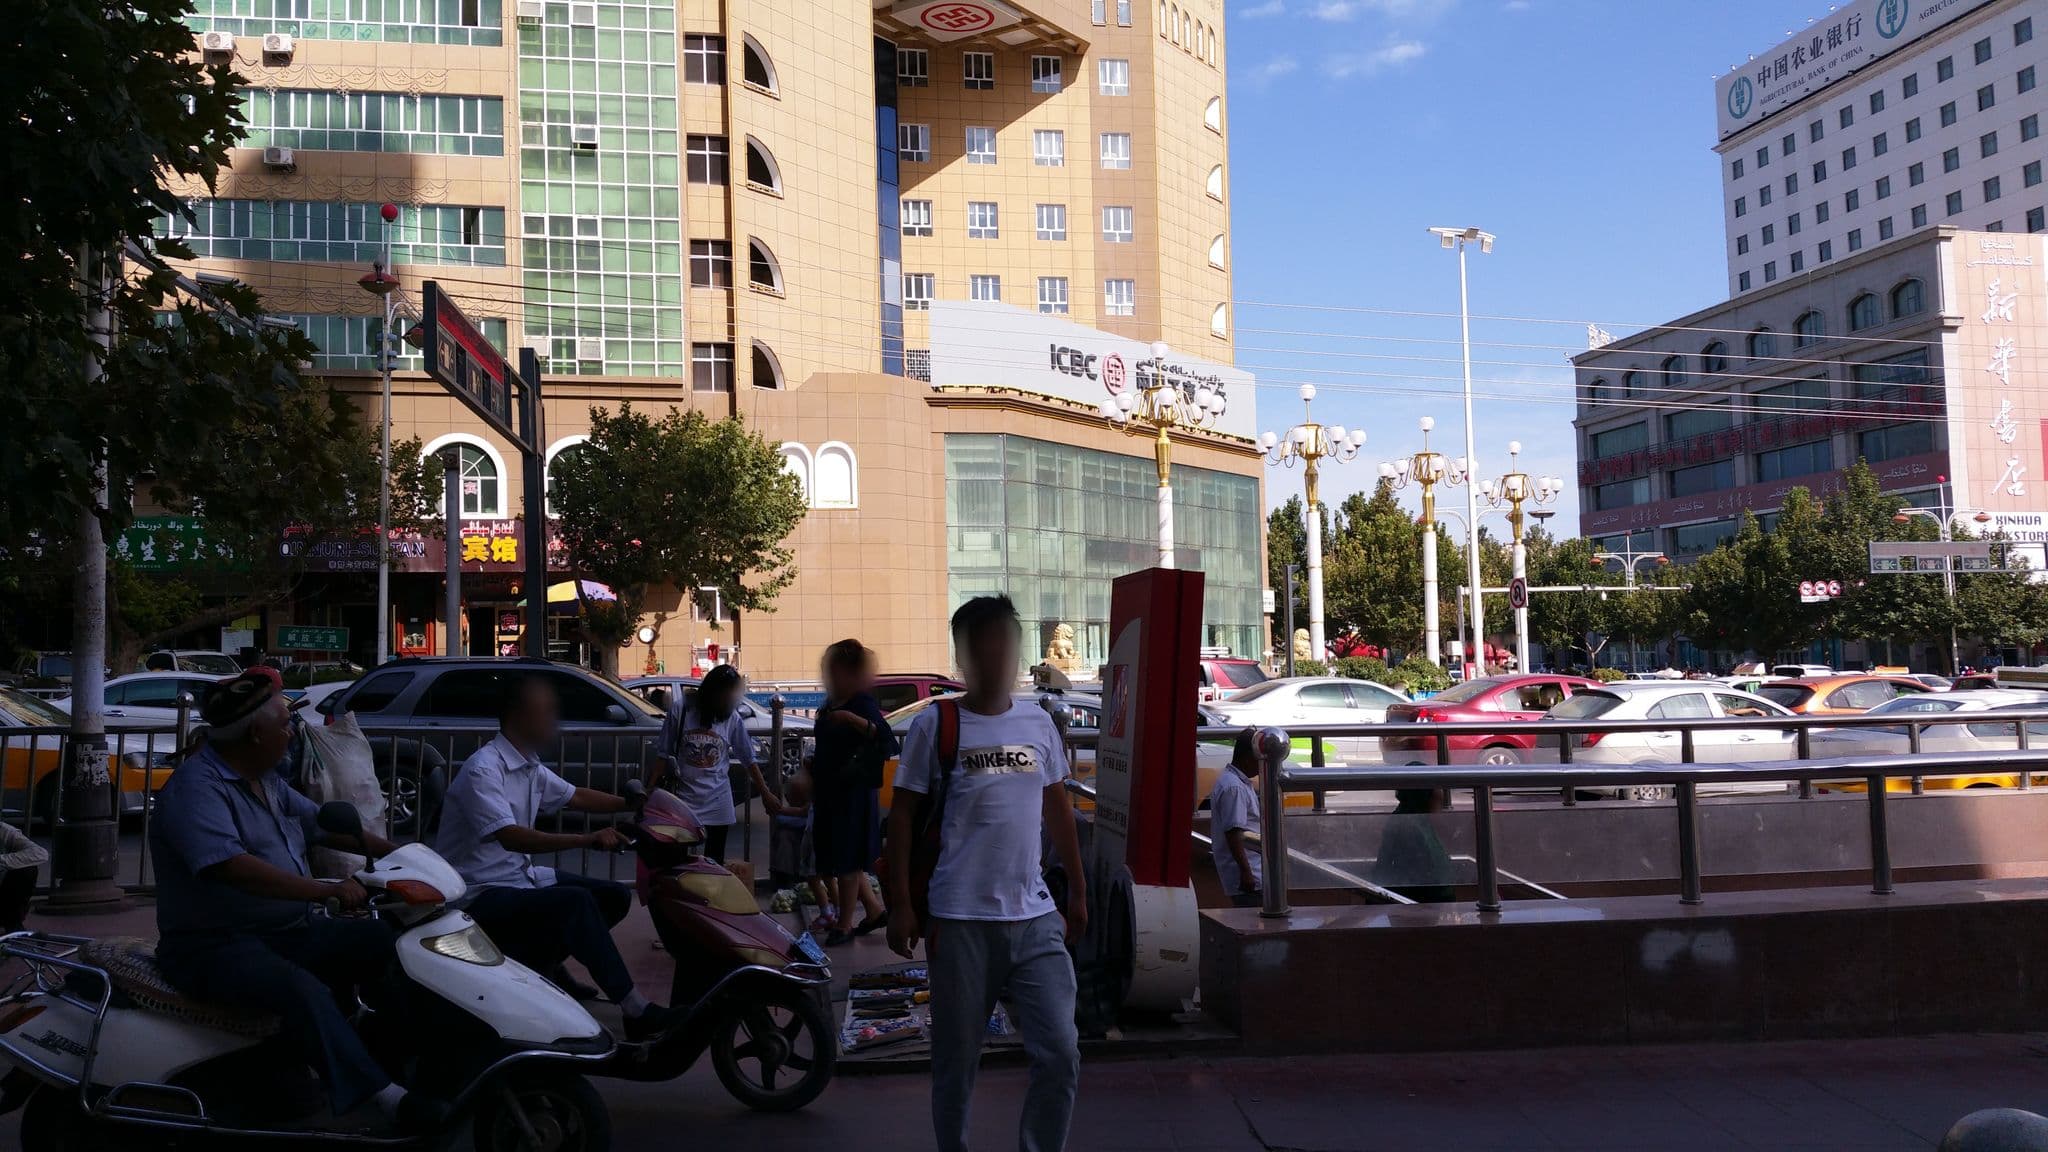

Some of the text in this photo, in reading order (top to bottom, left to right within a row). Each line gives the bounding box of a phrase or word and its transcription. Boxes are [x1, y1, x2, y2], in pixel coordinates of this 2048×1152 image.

[1757, 12, 1862, 88] 中国农业银行
[1760, 45, 1863, 106] AGRICULTURAL BANK OF CHINA
[1050, 343, 1097, 381] ICBC
[1995, 515, 2042, 526] XINHUA
[462, 535, 518, 563] 宾馆
[966, 752, 1006, 770] NIKE
